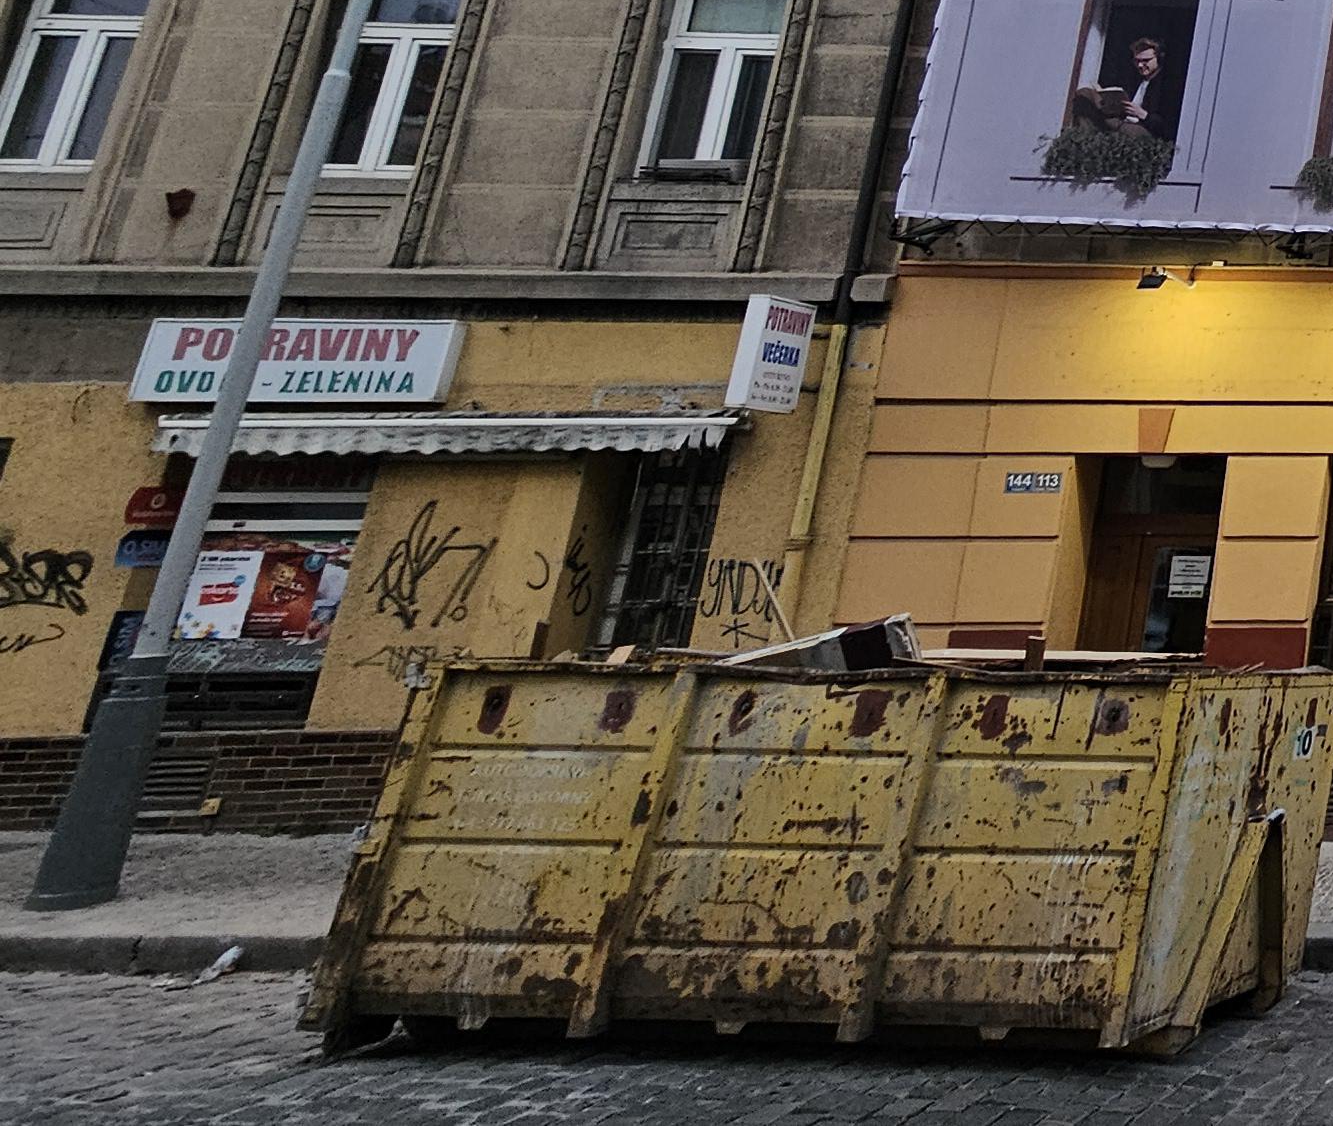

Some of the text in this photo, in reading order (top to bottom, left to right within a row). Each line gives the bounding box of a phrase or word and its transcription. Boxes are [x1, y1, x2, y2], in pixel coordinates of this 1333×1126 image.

[171, 326, 421, 363] PORAVINY
[277, 368, 416, 395] ZELENINA
[1007, 474, 1032, 488] 144
[1037, 474, 1060, 488] 113
